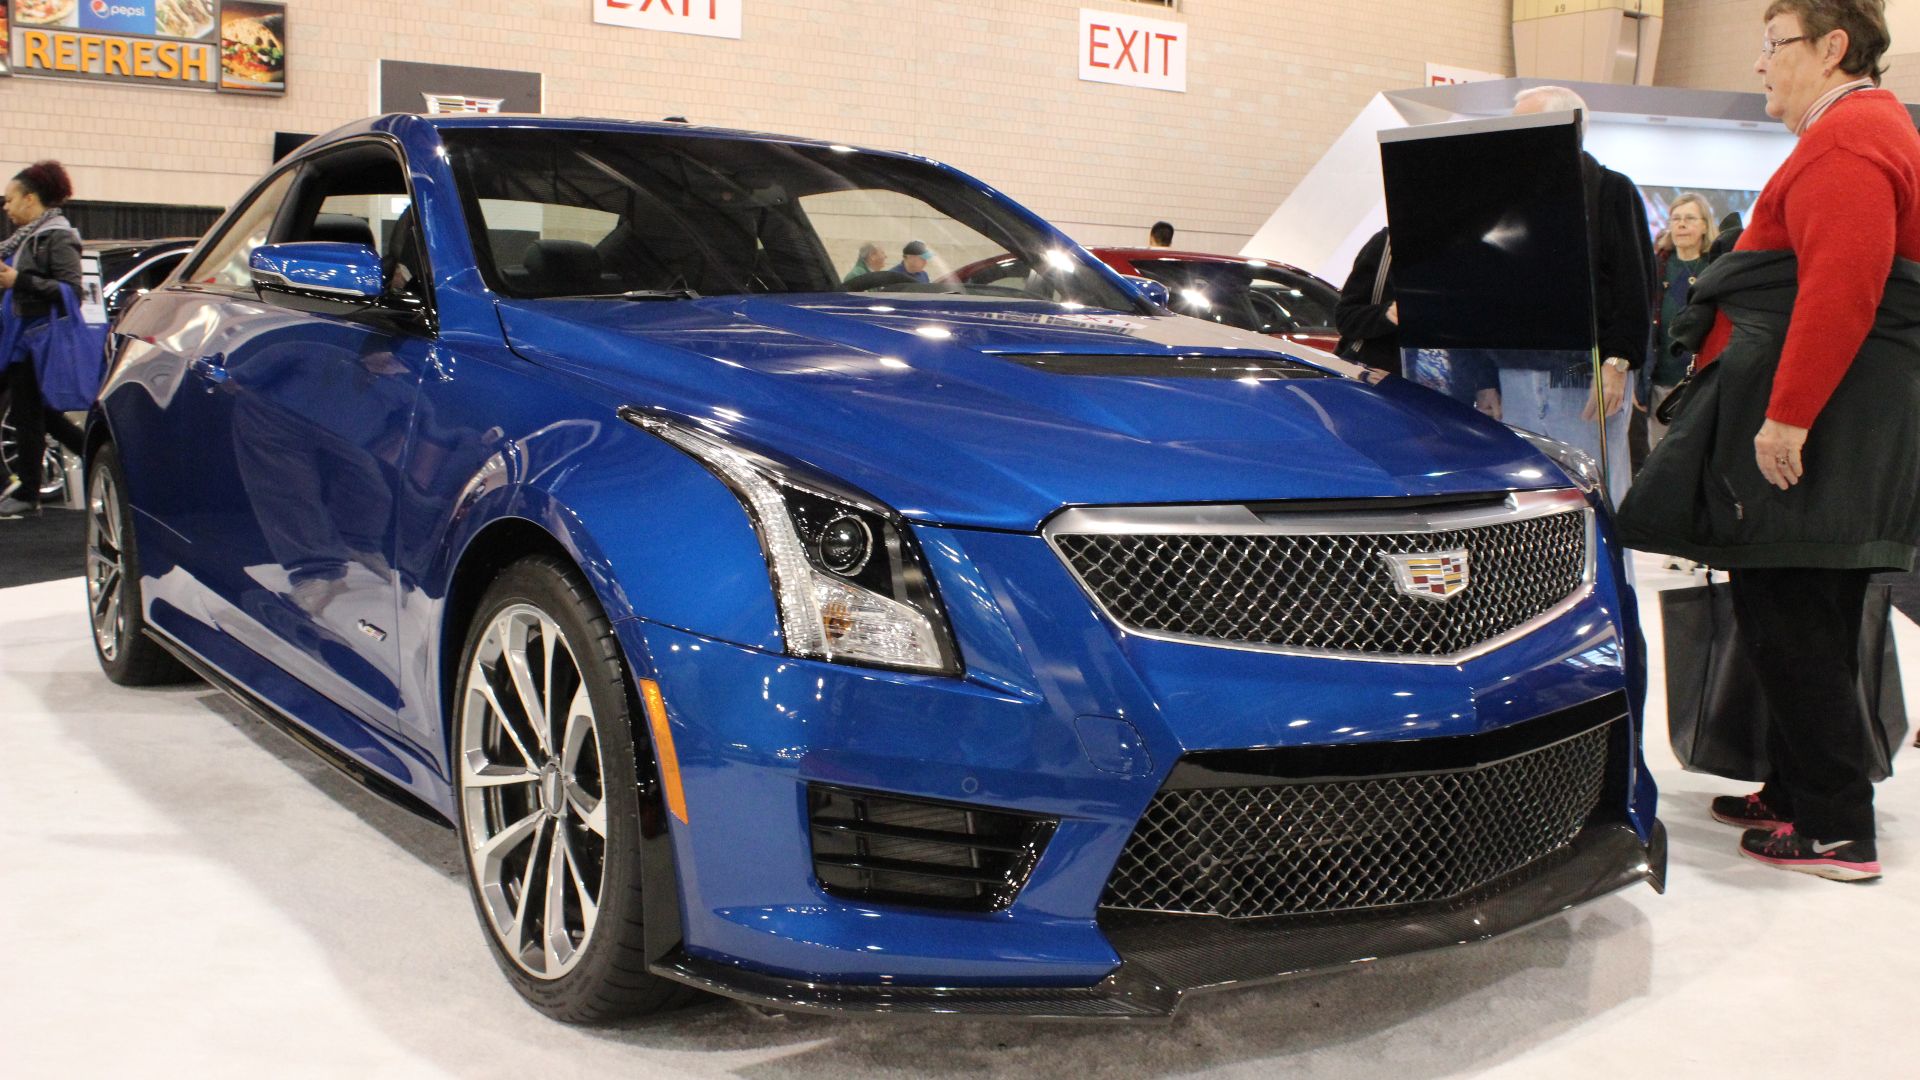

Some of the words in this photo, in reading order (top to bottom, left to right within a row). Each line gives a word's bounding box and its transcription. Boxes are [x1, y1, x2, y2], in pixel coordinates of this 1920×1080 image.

[110, 5, 145, 18] pepsi
[24, 31, 208, 81] REFRESH
[1089, 23, 1178, 76] EXIT
